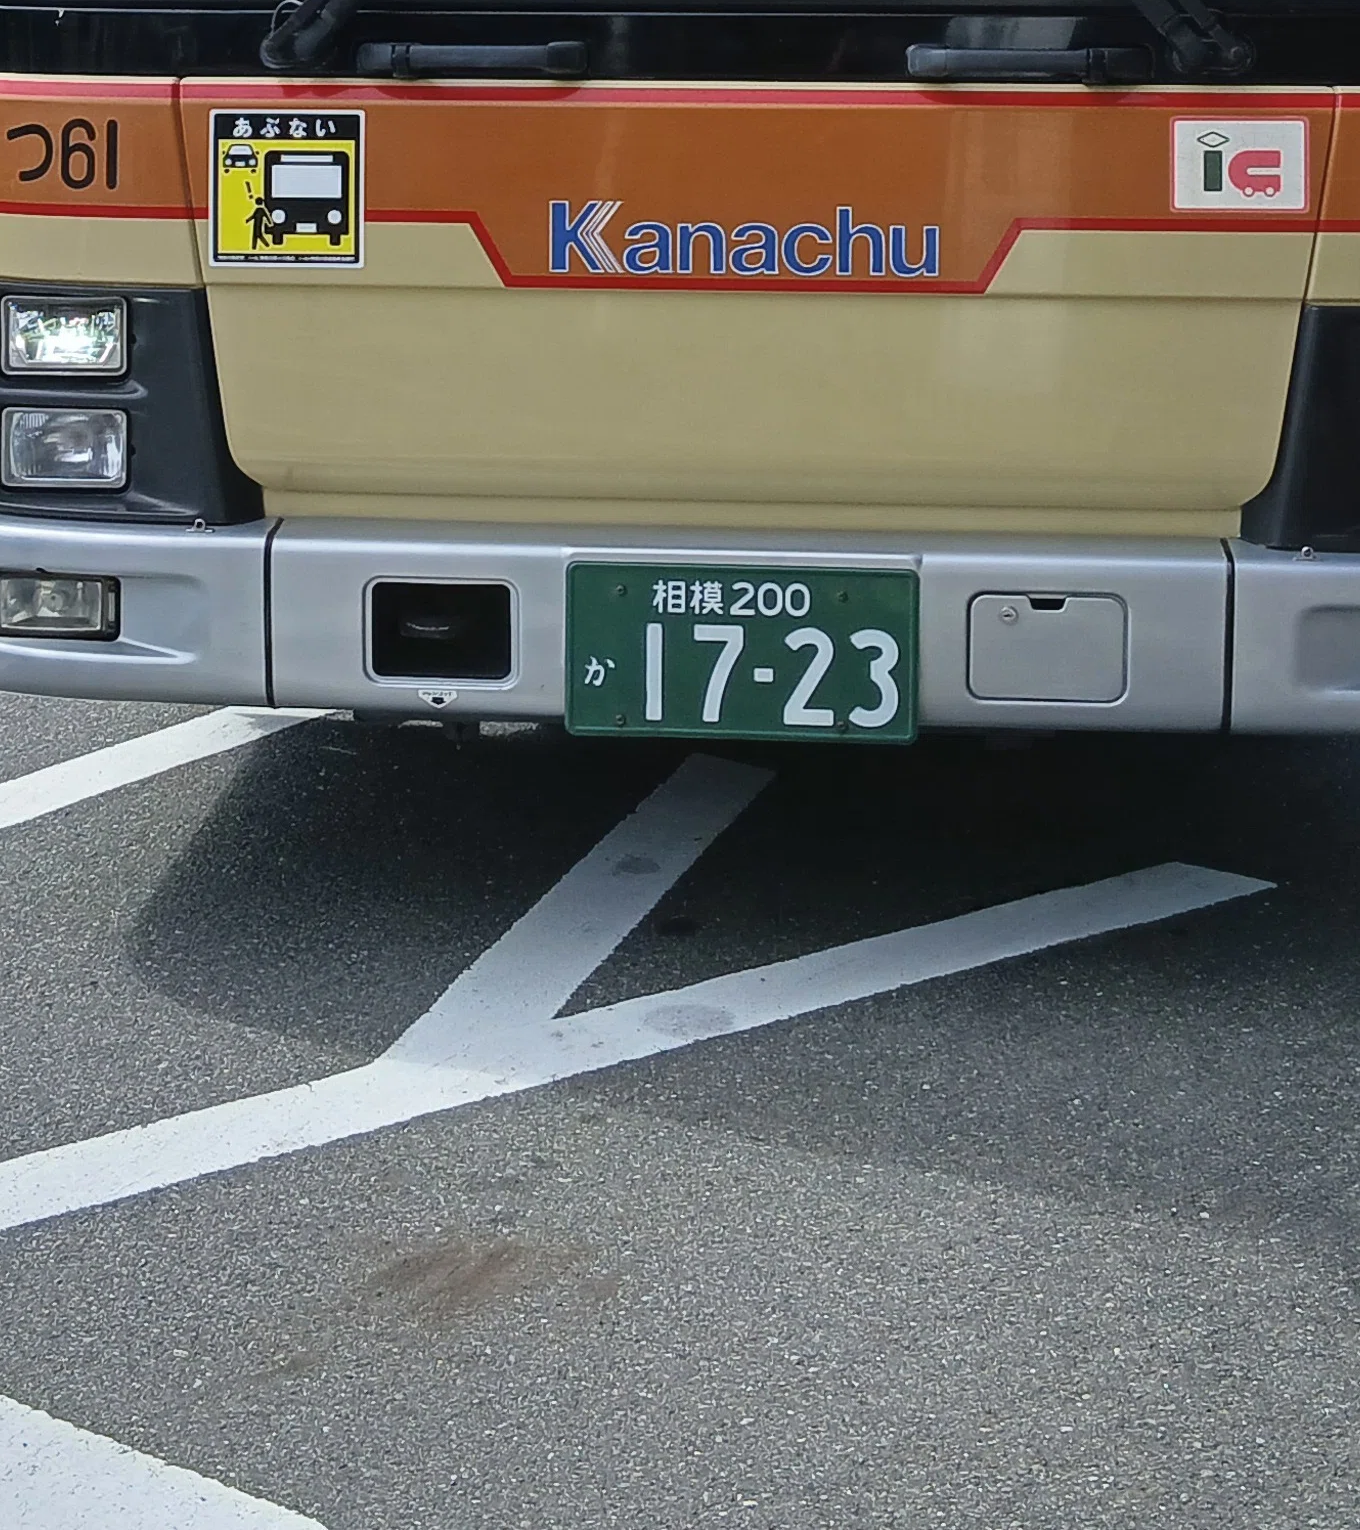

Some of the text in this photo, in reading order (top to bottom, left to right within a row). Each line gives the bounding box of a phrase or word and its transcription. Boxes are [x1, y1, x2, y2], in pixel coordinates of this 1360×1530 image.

[233, 117, 338, 138] あぶない
[548, 200, 940, 277] Kanachu
[583, 622, 900, 729] か 17-23
